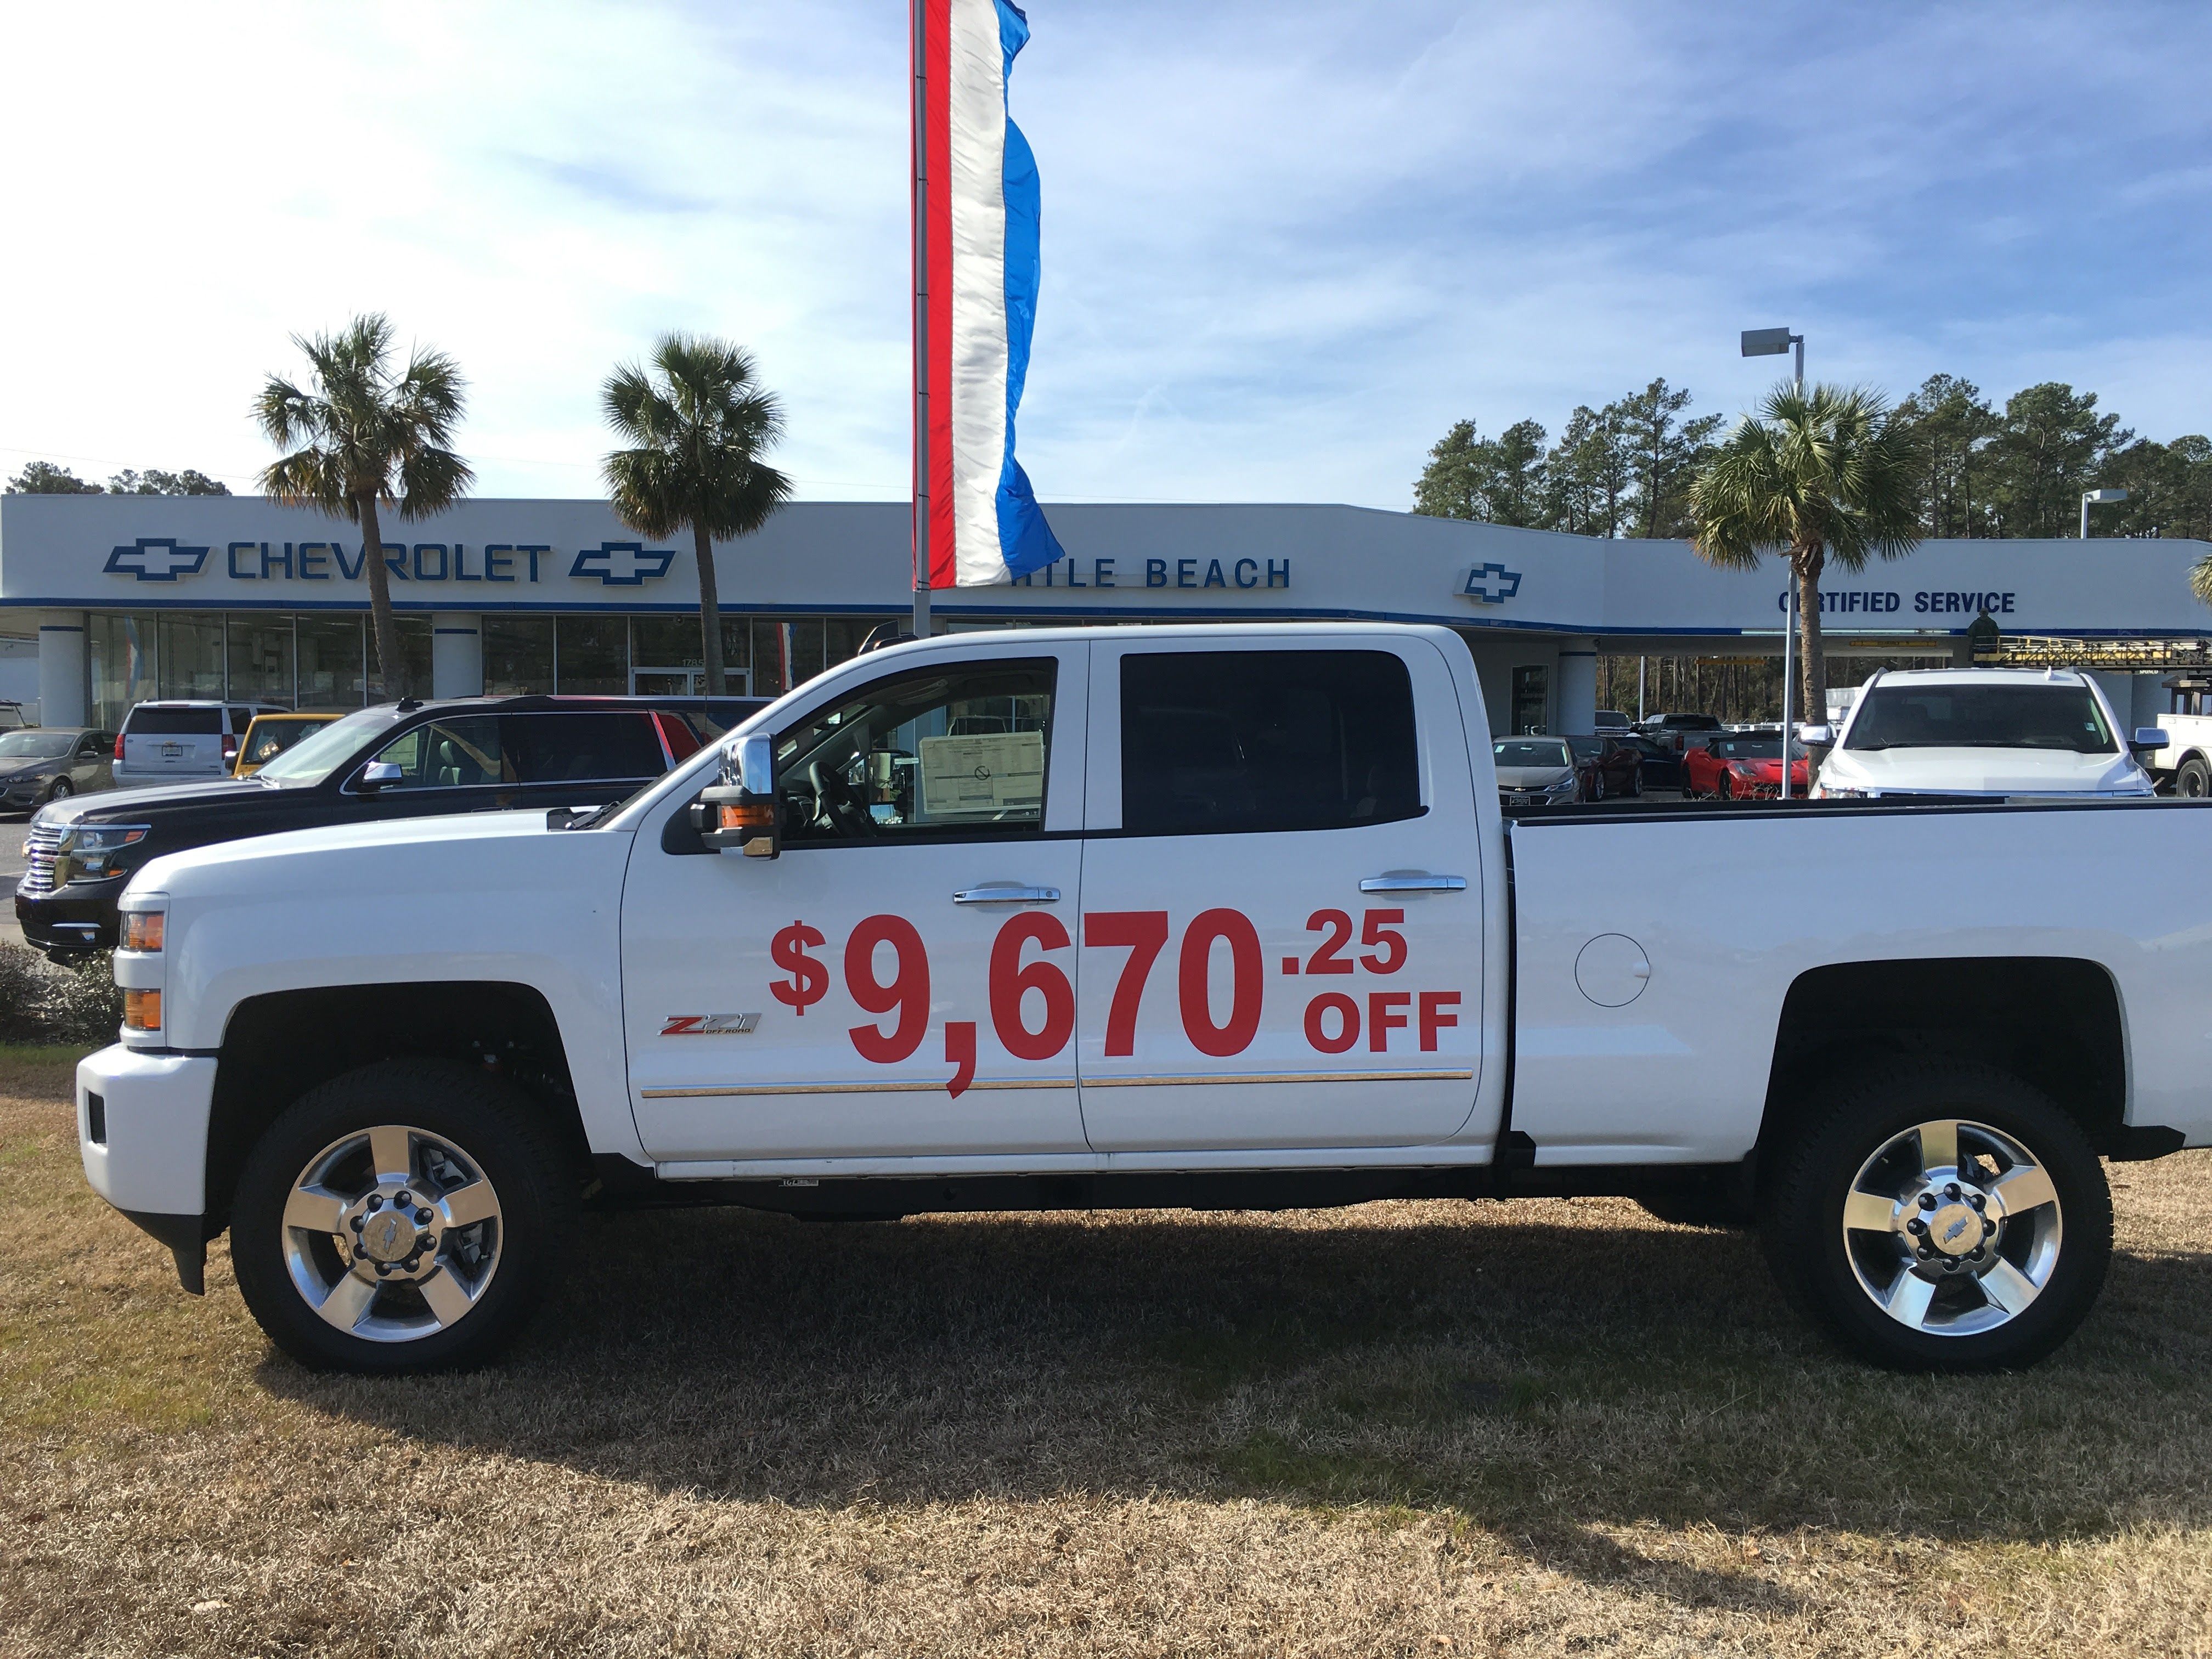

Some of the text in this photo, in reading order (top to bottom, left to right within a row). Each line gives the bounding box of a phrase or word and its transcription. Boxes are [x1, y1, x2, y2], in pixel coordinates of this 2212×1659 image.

[228, 542, 551, 582] CHEVROLET
[1146, 558, 1290, 588] BEACH
[1778, 591, 2016, 613] CTIFIED SERVICE
[658, 1013, 763, 1035] Z71
[1304, 991, 1462, 1054] OFF
